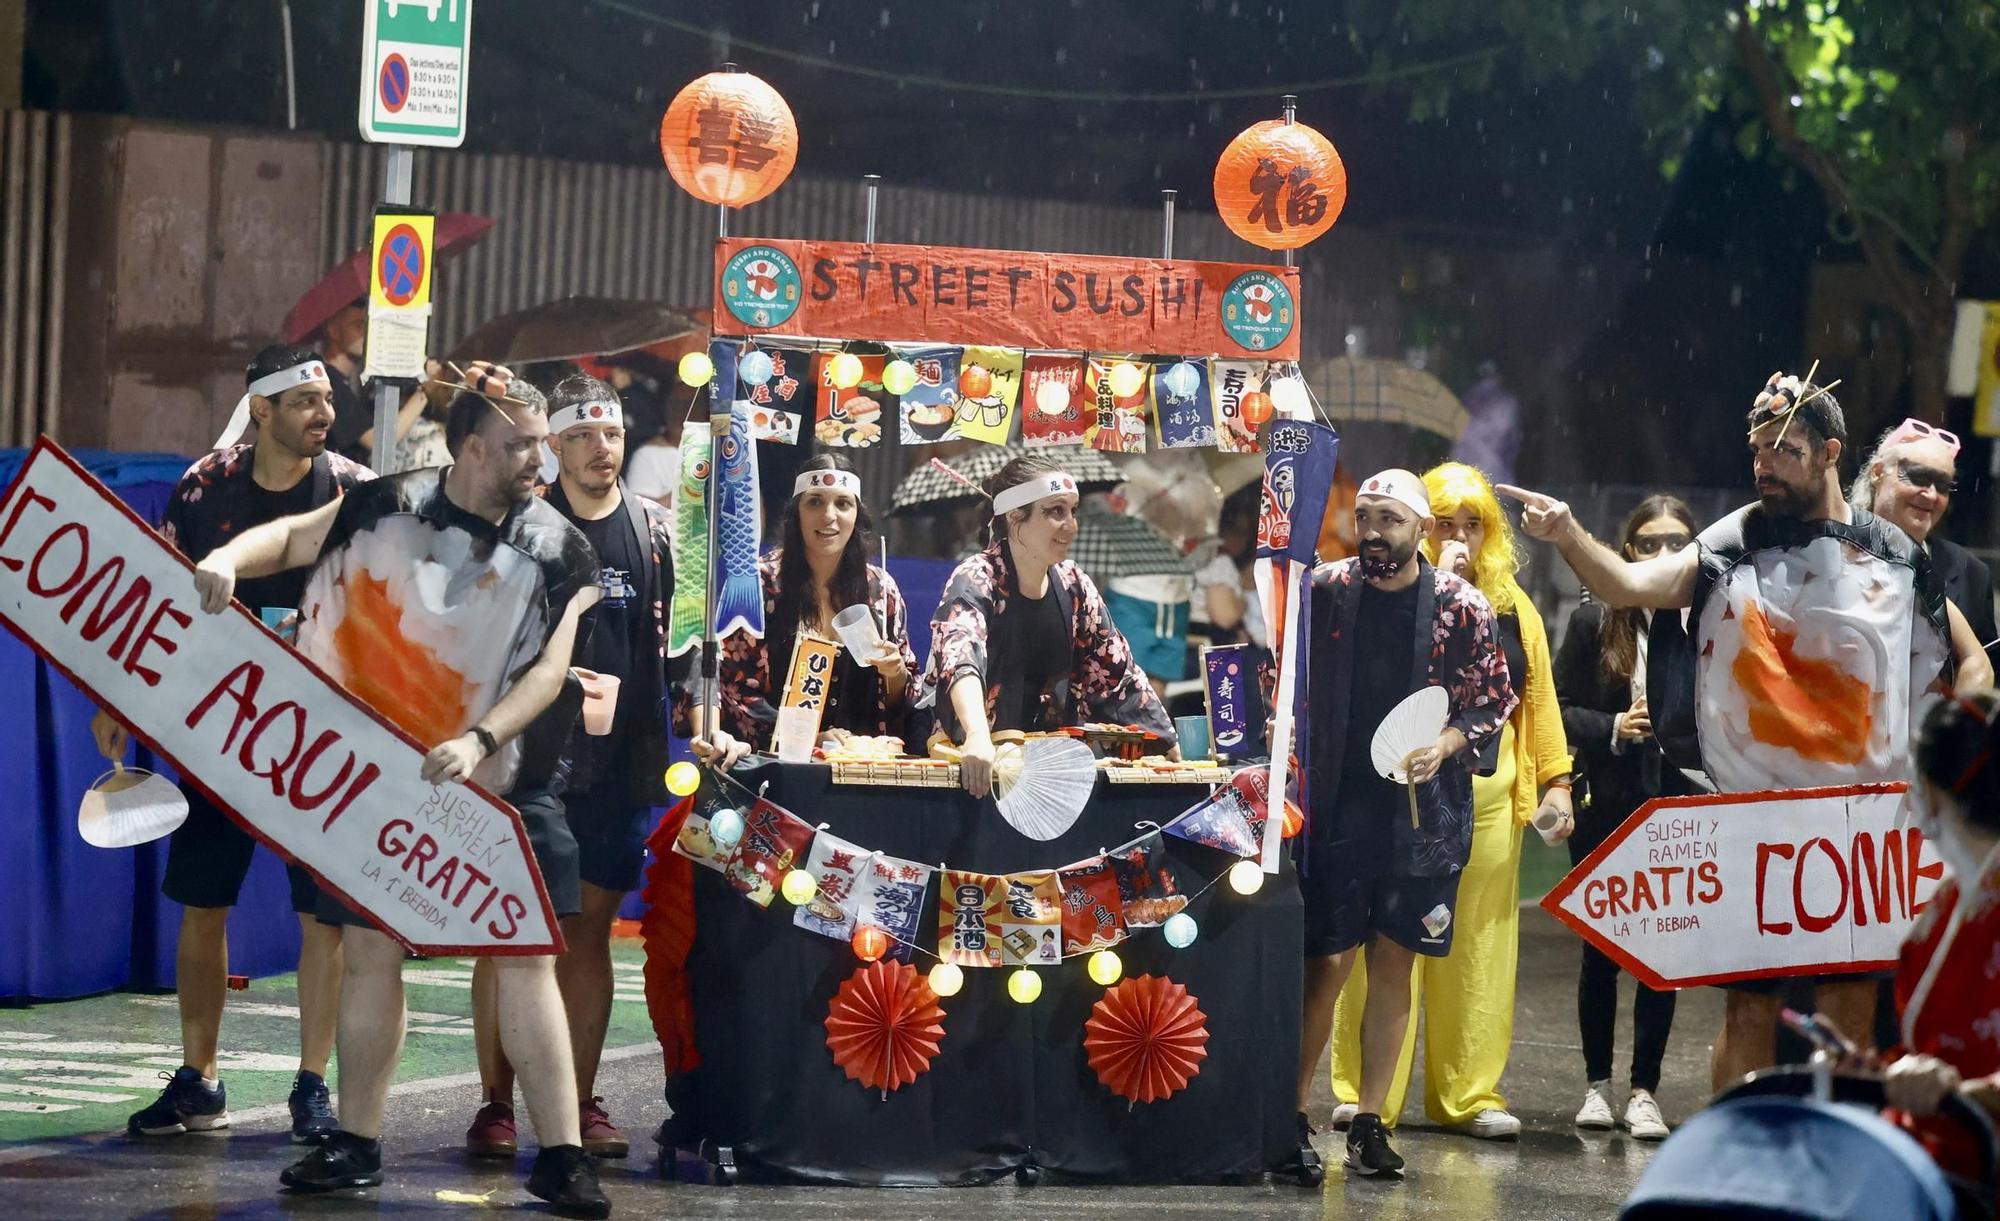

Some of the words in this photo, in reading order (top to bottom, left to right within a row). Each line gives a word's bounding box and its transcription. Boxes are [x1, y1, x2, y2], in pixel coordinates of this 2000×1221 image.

[1247, 157, 1328, 233] 福
[731, 253, 752, 271] SUSHI
[752, 249, 770, 257] AND
[771, 252, 793, 275] RAMEN
[811, 256, 1032, 313] STREET
[1052, 270, 1203, 320] SUSHI
[1231, 278, 1249, 296] SUSHI
[1267, 277, 1286, 298] RAMEN
[0, 486, 193, 687] COME
[185, 660, 381, 833] AQUI
[1217, 676, 1235, 722] 寿司
[416, 800, 502, 868] RAMEN
[429, 783, 490, 832] SUSHI
[1645, 819, 1700, 842] SUSHI
[377, 818, 528, 940] GRATIS
[1648, 840, 1718, 863] RAMEN
[1755, 826, 1945, 937] COME
[361, 860, 381, 882] LA
[399, 886, 448, 931] BEBIDA
[953, 884, 987, 951] 日本酒
[1583, 860, 1724, 919] GRATIS
[1613, 922, 1631, 938] LA
[1656, 915, 1700, 933] BEBIDA
